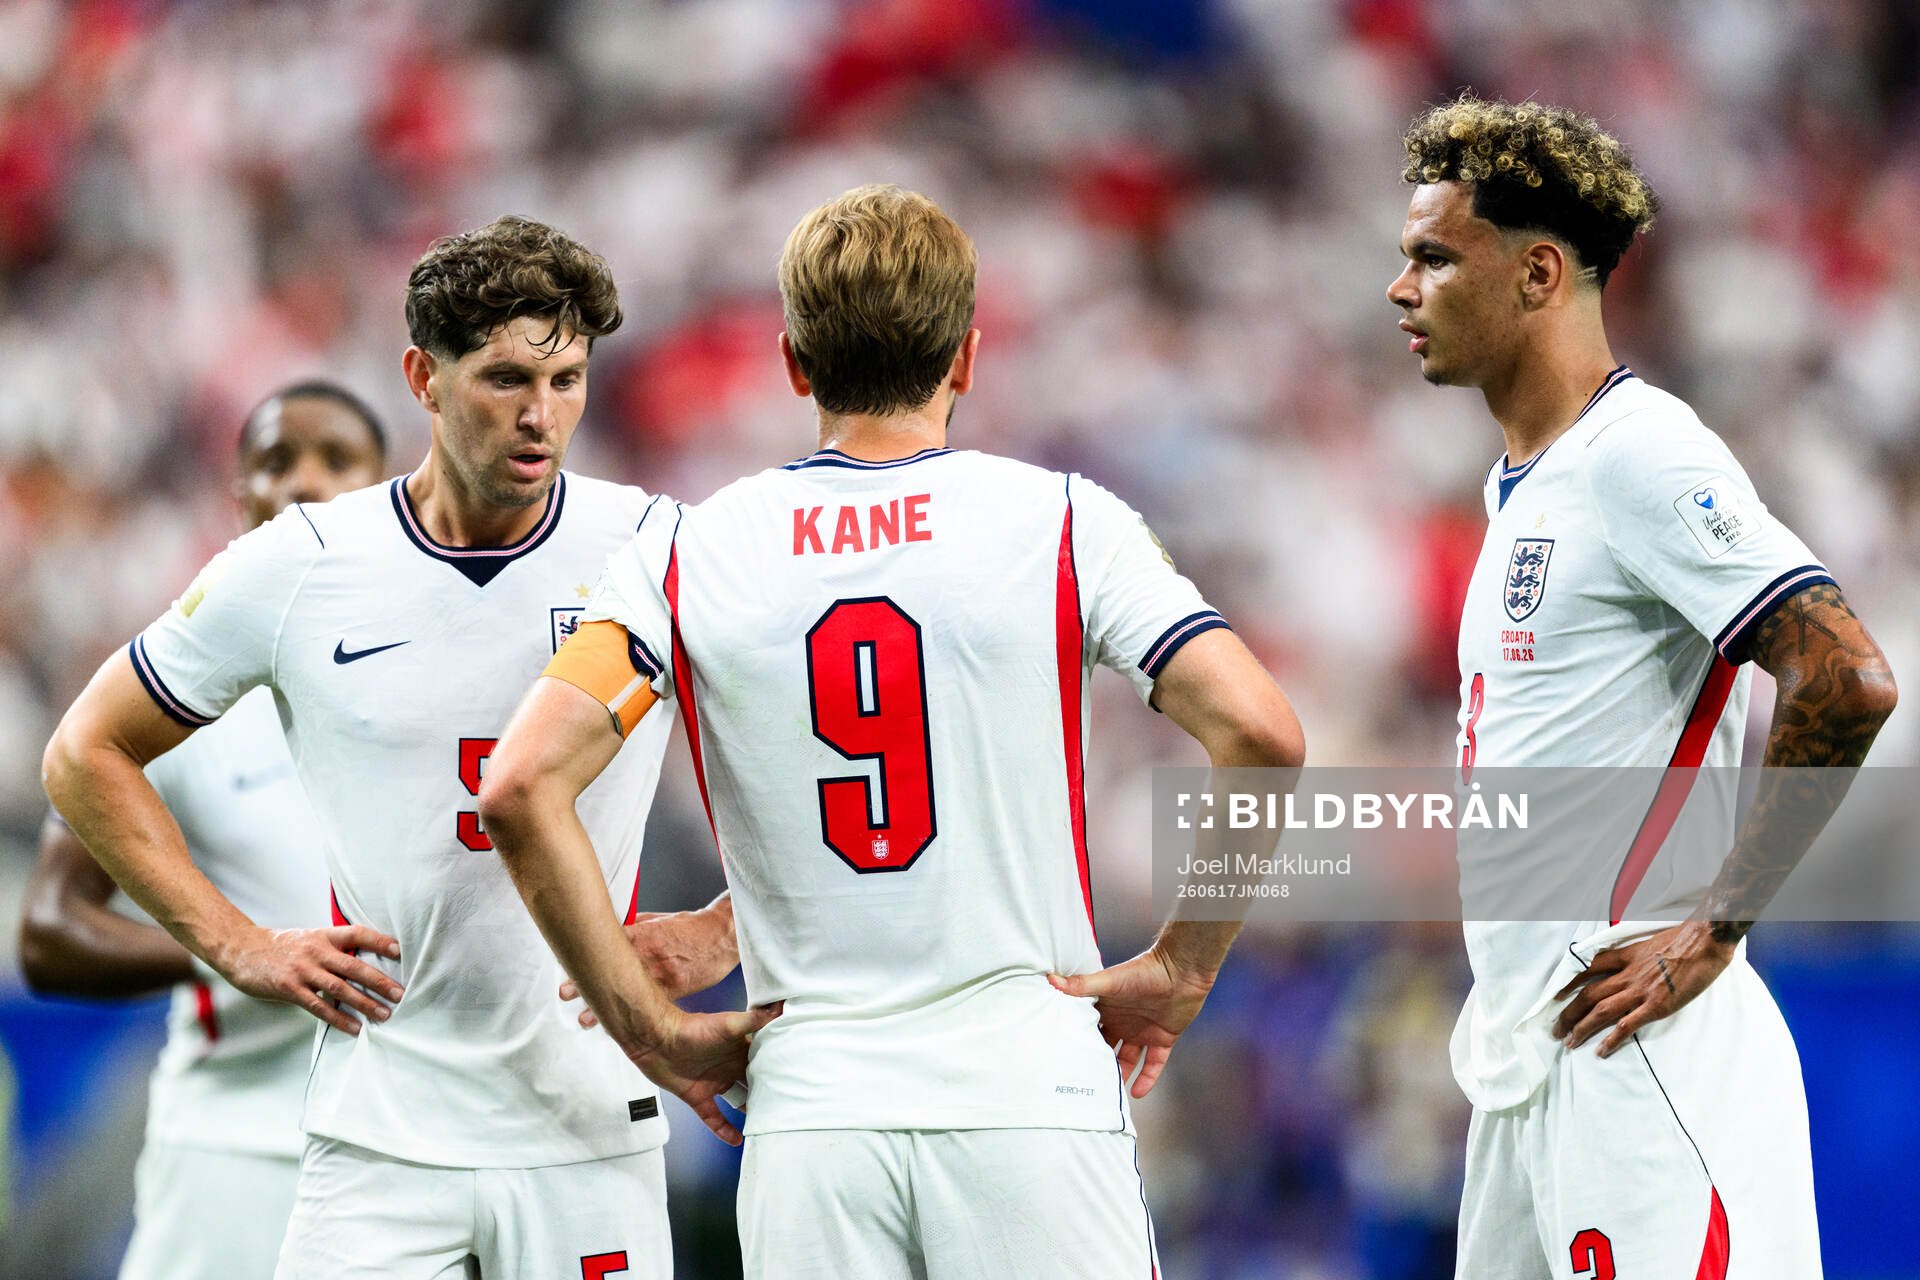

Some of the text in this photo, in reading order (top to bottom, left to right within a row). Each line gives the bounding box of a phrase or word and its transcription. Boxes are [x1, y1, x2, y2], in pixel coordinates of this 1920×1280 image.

[793, 493, 932, 556] KANE
[1711, 515, 1742, 540] PEACE
[1725, 530, 1741, 543] FIFA
[1501, 630, 1535, 645] CROATIA
[1503, 647, 1534, 662] 17.06.26
[805, 595, 938, 874] 9
[1461, 672, 1484, 786] 3
